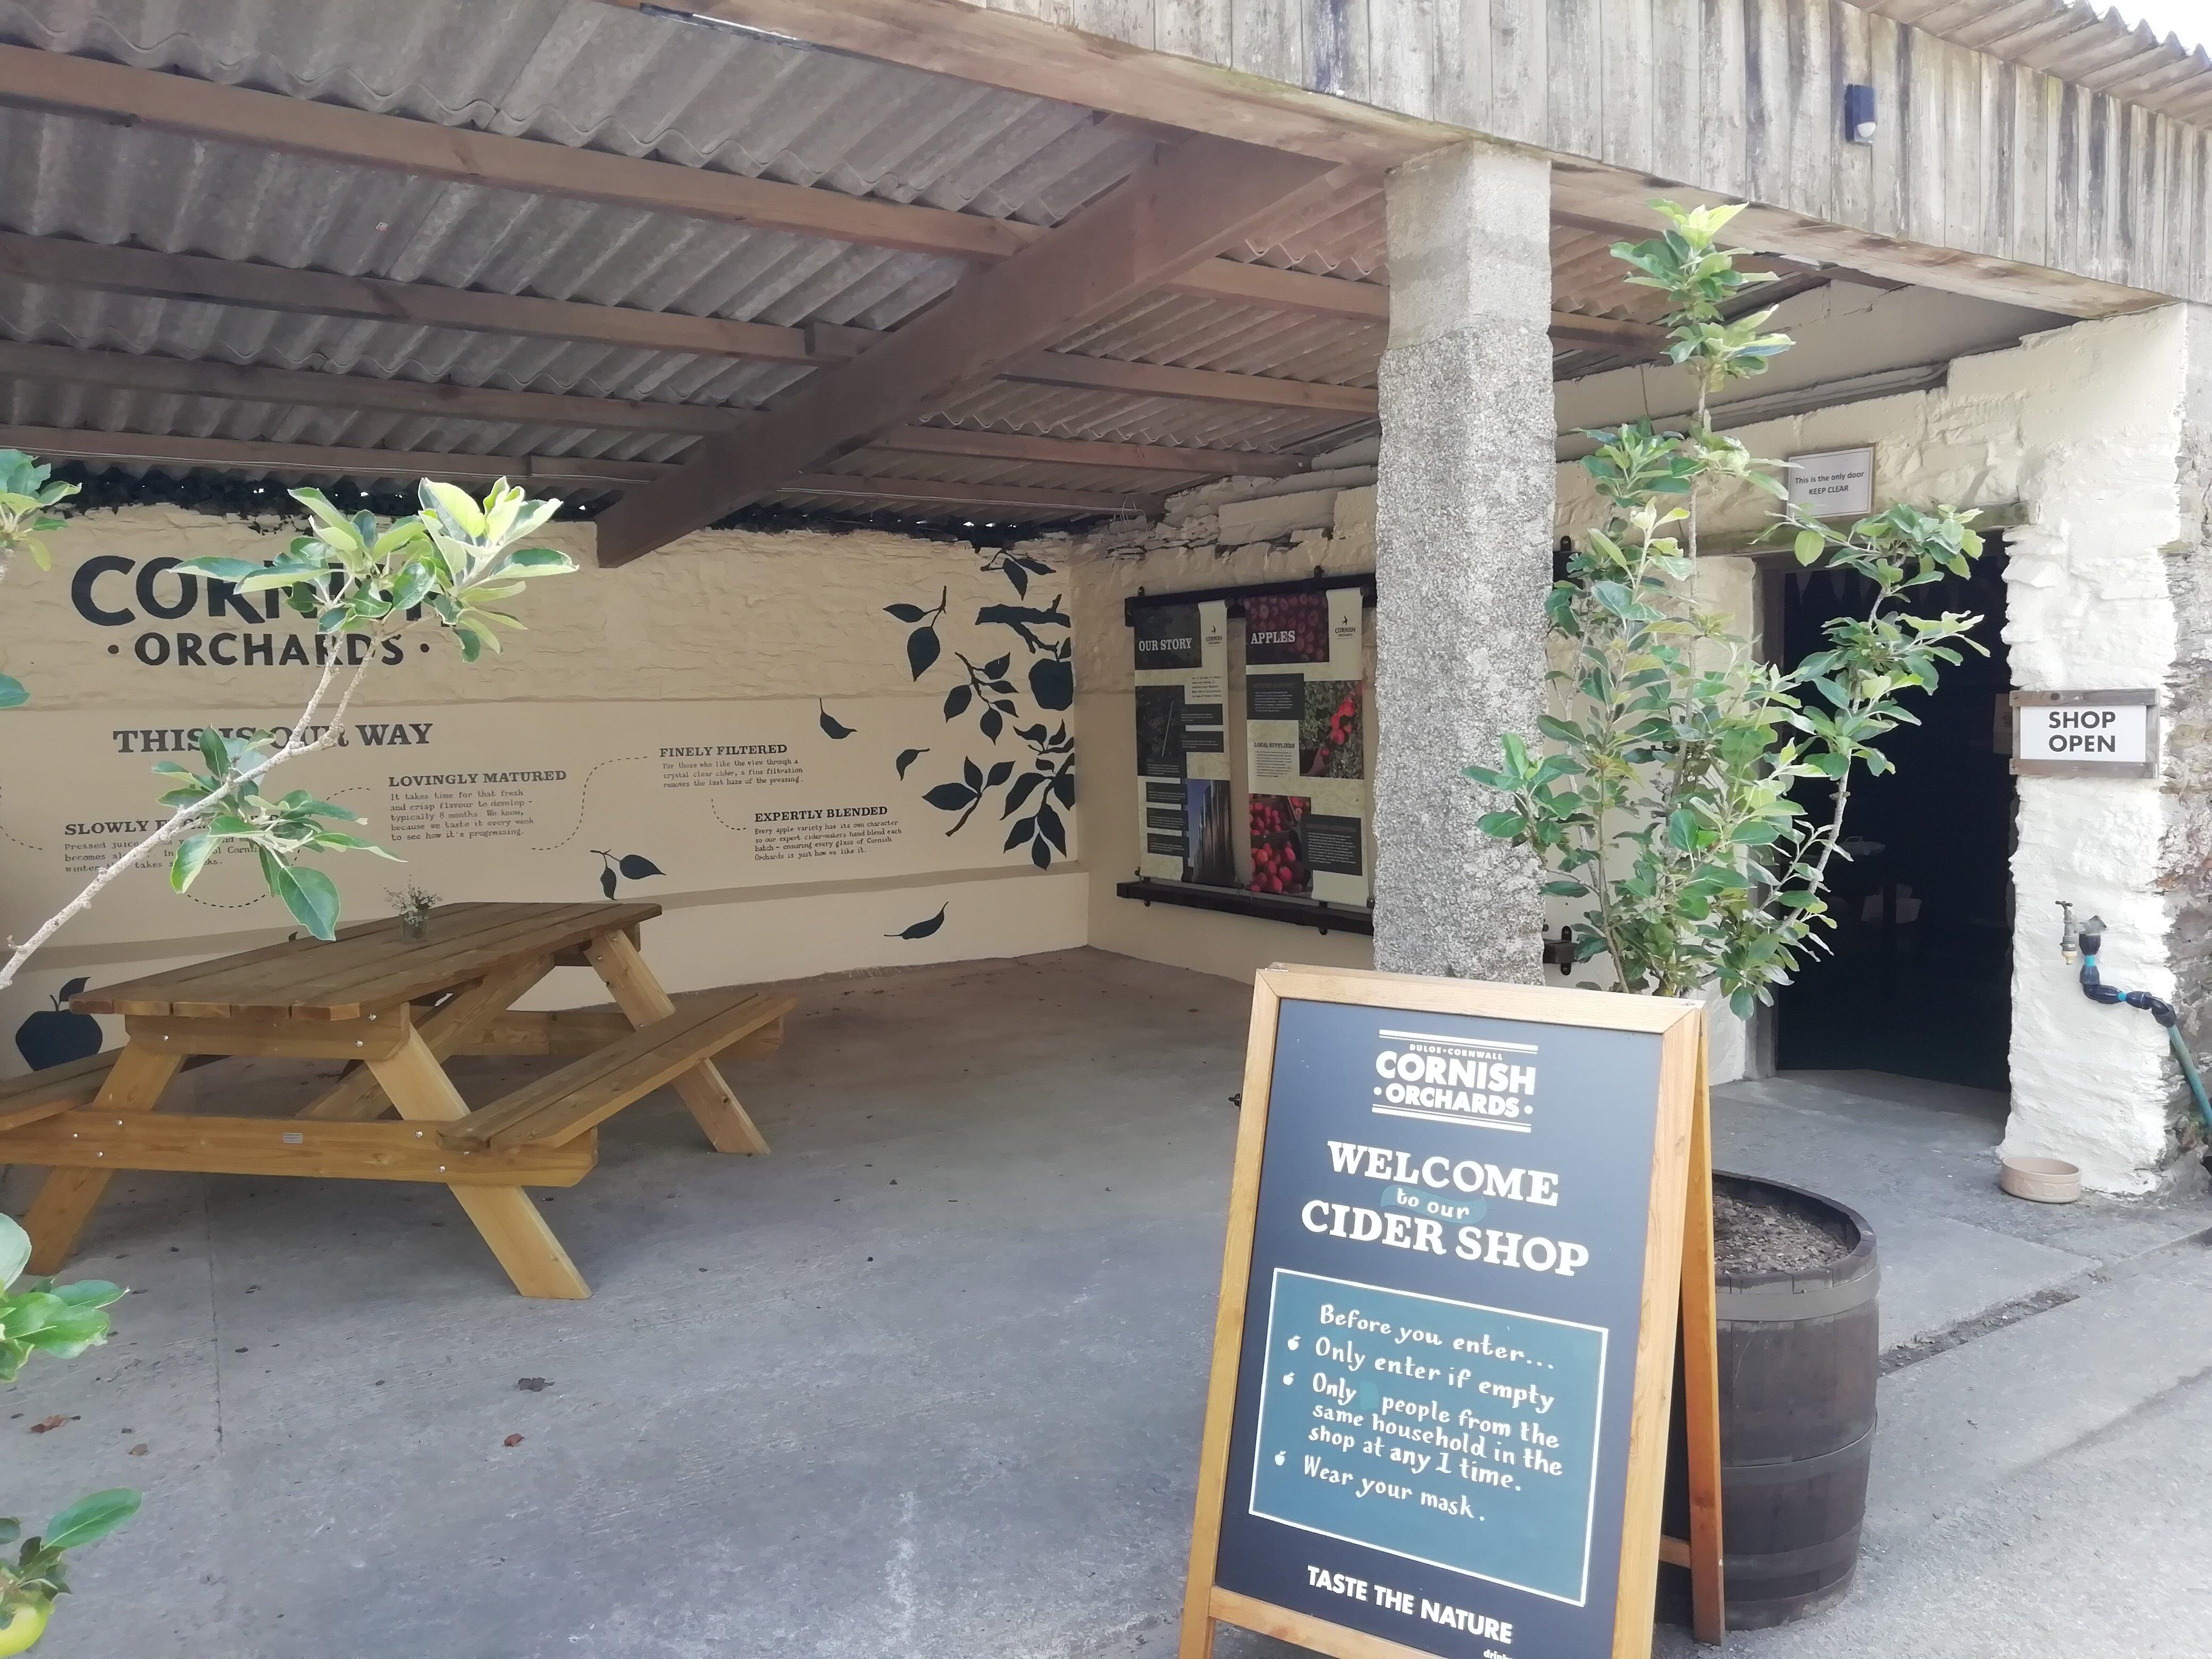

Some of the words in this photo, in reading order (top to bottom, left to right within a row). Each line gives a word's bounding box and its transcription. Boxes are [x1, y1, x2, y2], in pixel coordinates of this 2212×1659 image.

[1828, 485, 1849, 493] CLEAR
[1138, 640, 1159, 652] OUR
[1160, 638, 1192, 650] STORY
[1250, 630, 1295, 644] APPLES
[135, 632, 404, 666] ORCHARDS
[2049, 711, 2116, 728] SHOP
[113, 728, 205, 753] THIS
[355, 723, 433, 745] WAY
[2049, 734, 2115, 752] OPEN
[659, 747, 713, 757] FINELY
[716, 744, 787, 755] FILTERED
[388, 774, 479, 786] LOVINGLY
[483, 770, 567, 783] MATURED
[769, 776, 803, 785] pressing.
[409, 803, 435, 811] crisp
[755, 809, 823, 822] EXPERTLY
[826, 806, 887, 818] BLENDED
[391, 812, 435, 823] typically
[64, 820, 149, 835] SLOWLY
[468, 828, 524, 839] progressing.
[64, 842, 106, 850] Pressed
[112, 841, 139, 849] juice
[1409, 1044, 1442, 1054] DULOE
[1447, 1048, 1503, 1060] CORNWALL
[1376, 1050, 1536, 1095] CORNISH
[1385, 1083, 1520, 1118] ORCHARDS
[1327, 1141, 1559, 1206] WELCOME
[1396, 1187, 1419, 1207] to
[1427, 1201, 1470, 1220] our
[1301, 1200, 1447, 1255] CIDER
[1455, 1226, 1589, 1276] SHOP
[1320, 1304, 1392, 1334] Before
[1394, 1327, 1443, 1345] you
[1453, 1334, 1554, 1369] enter...
[1316, 1336, 1365, 1372] Only
[1375, 1356, 1442, 1380] enter
[1448, 1367, 1471, 1388] if
[1478, 1381, 1555, 1414] empty
[1312, 1372, 1356, 1406] Only
[1382, 1396, 1450, 1422] people
[1459, 1409, 1511, 1437] from
[1520, 1422, 1560, 1448] the
[1312, 1404, 1364, 1426] same
[1372, 1413, 1487, 1459] household
[1494, 1441, 1515, 1465] in
[1523, 1448, 1563, 1476] the
[1308, 1425, 1355, 1452] shop
[1363, 1436, 1385, 1457] at
[1390, 1447, 1431, 1474] any
[1435, 1452, 1452, 1473] 1
[1459, 1458, 1521, 1492] time.
[1304, 1455, 1353, 1485] Wear
[1355, 1478, 1413, 1499] your
[1421, 1492, 1485, 1521] mask.
[1308, 1565, 1368, 1602] TASTE
[1374, 1584, 1414, 1615] THE
[1420, 1598, 1512, 1644] NATURE
